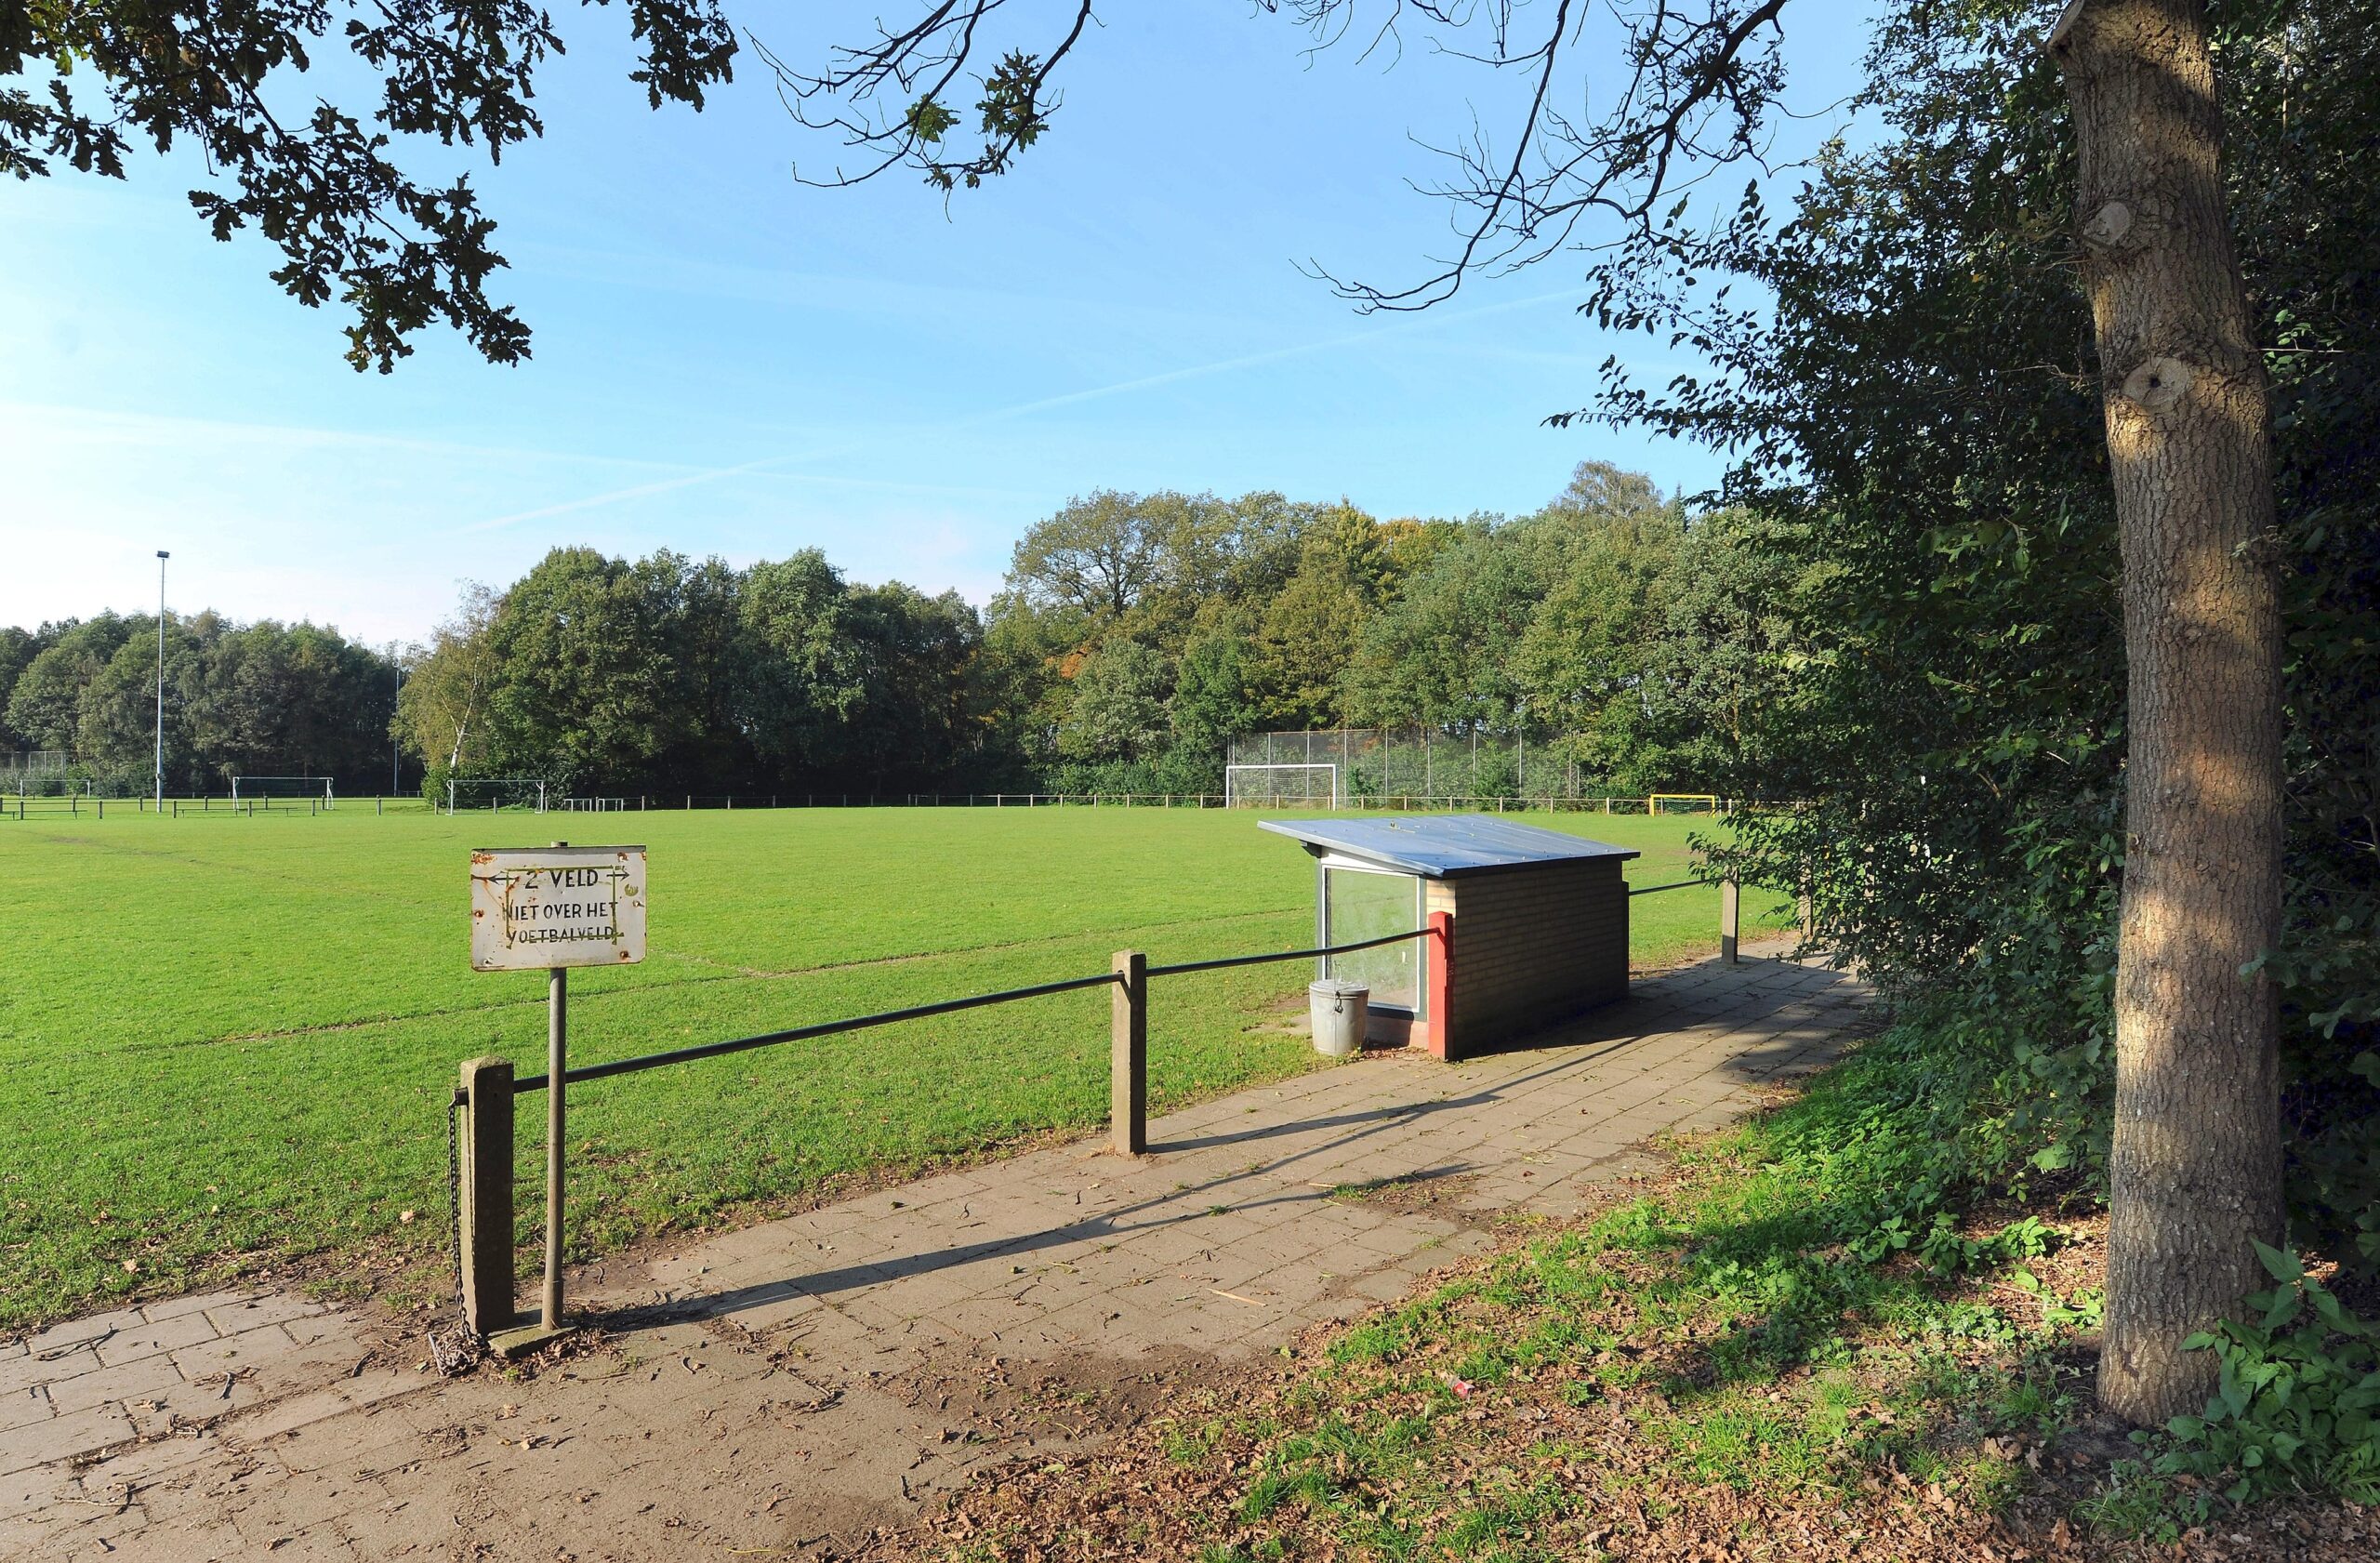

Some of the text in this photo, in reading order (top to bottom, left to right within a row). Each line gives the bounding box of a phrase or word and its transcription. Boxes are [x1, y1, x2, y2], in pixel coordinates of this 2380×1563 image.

[549, 868, 599, 888] VELD
[502, 900, 618, 921] NIET OVER HET
[509, 926, 615, 945] VOETBALVELD
